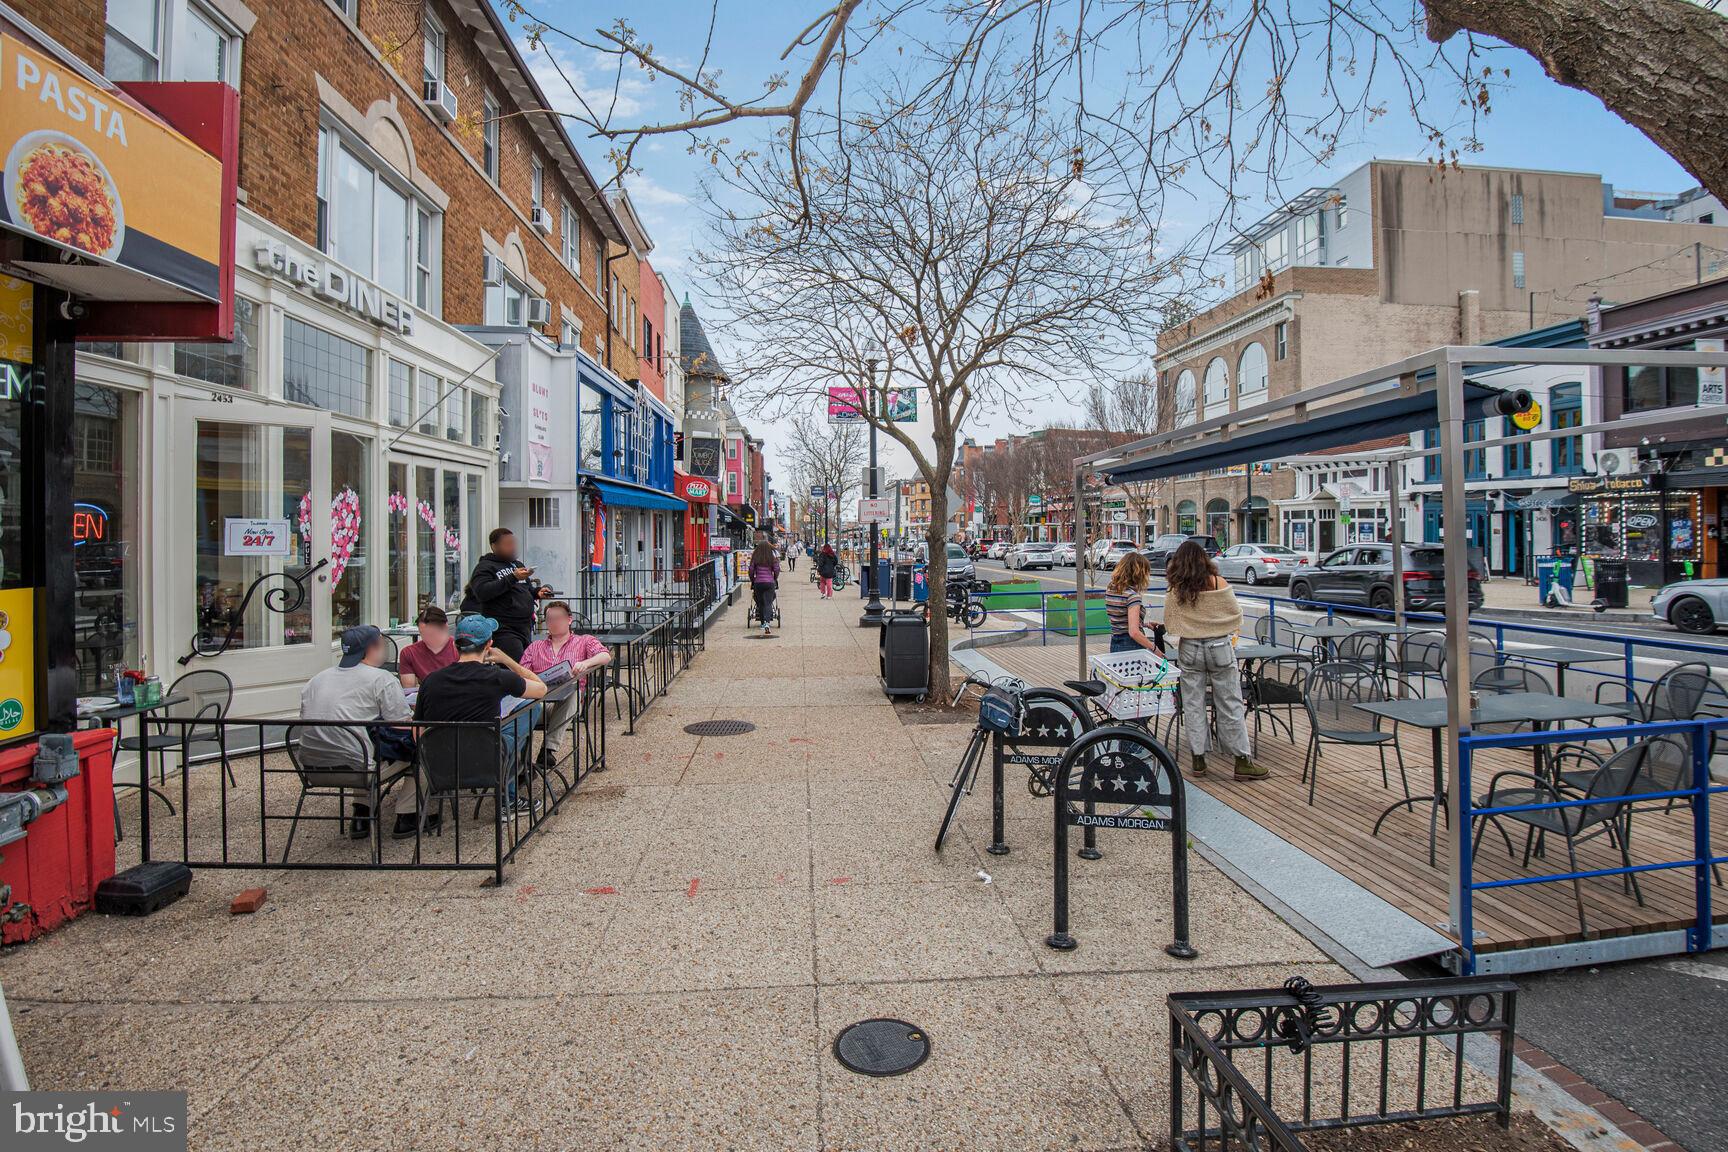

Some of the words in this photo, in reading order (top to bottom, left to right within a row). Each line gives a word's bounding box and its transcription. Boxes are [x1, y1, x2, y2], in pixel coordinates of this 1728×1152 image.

[17, 53, 128, 148] PASTA
[257, 240, 321, 289] the
[319, 260, 415, 337] DINER
[1702, 384, 1723, 394] ARTS
[211, 393, 234, 404] 2453
[689, 489, 707, 497] MART
[1630, 517, 1655, 527] OPEN
[244, 527, 259, 536] Now
[242, 534, 276, 547] 24/7
[1010, 755, 1040, 764] ADAMS
[1076, 815, 1115, 827] ADAMS
[1117, 818, 1164, 830] MORGAN
